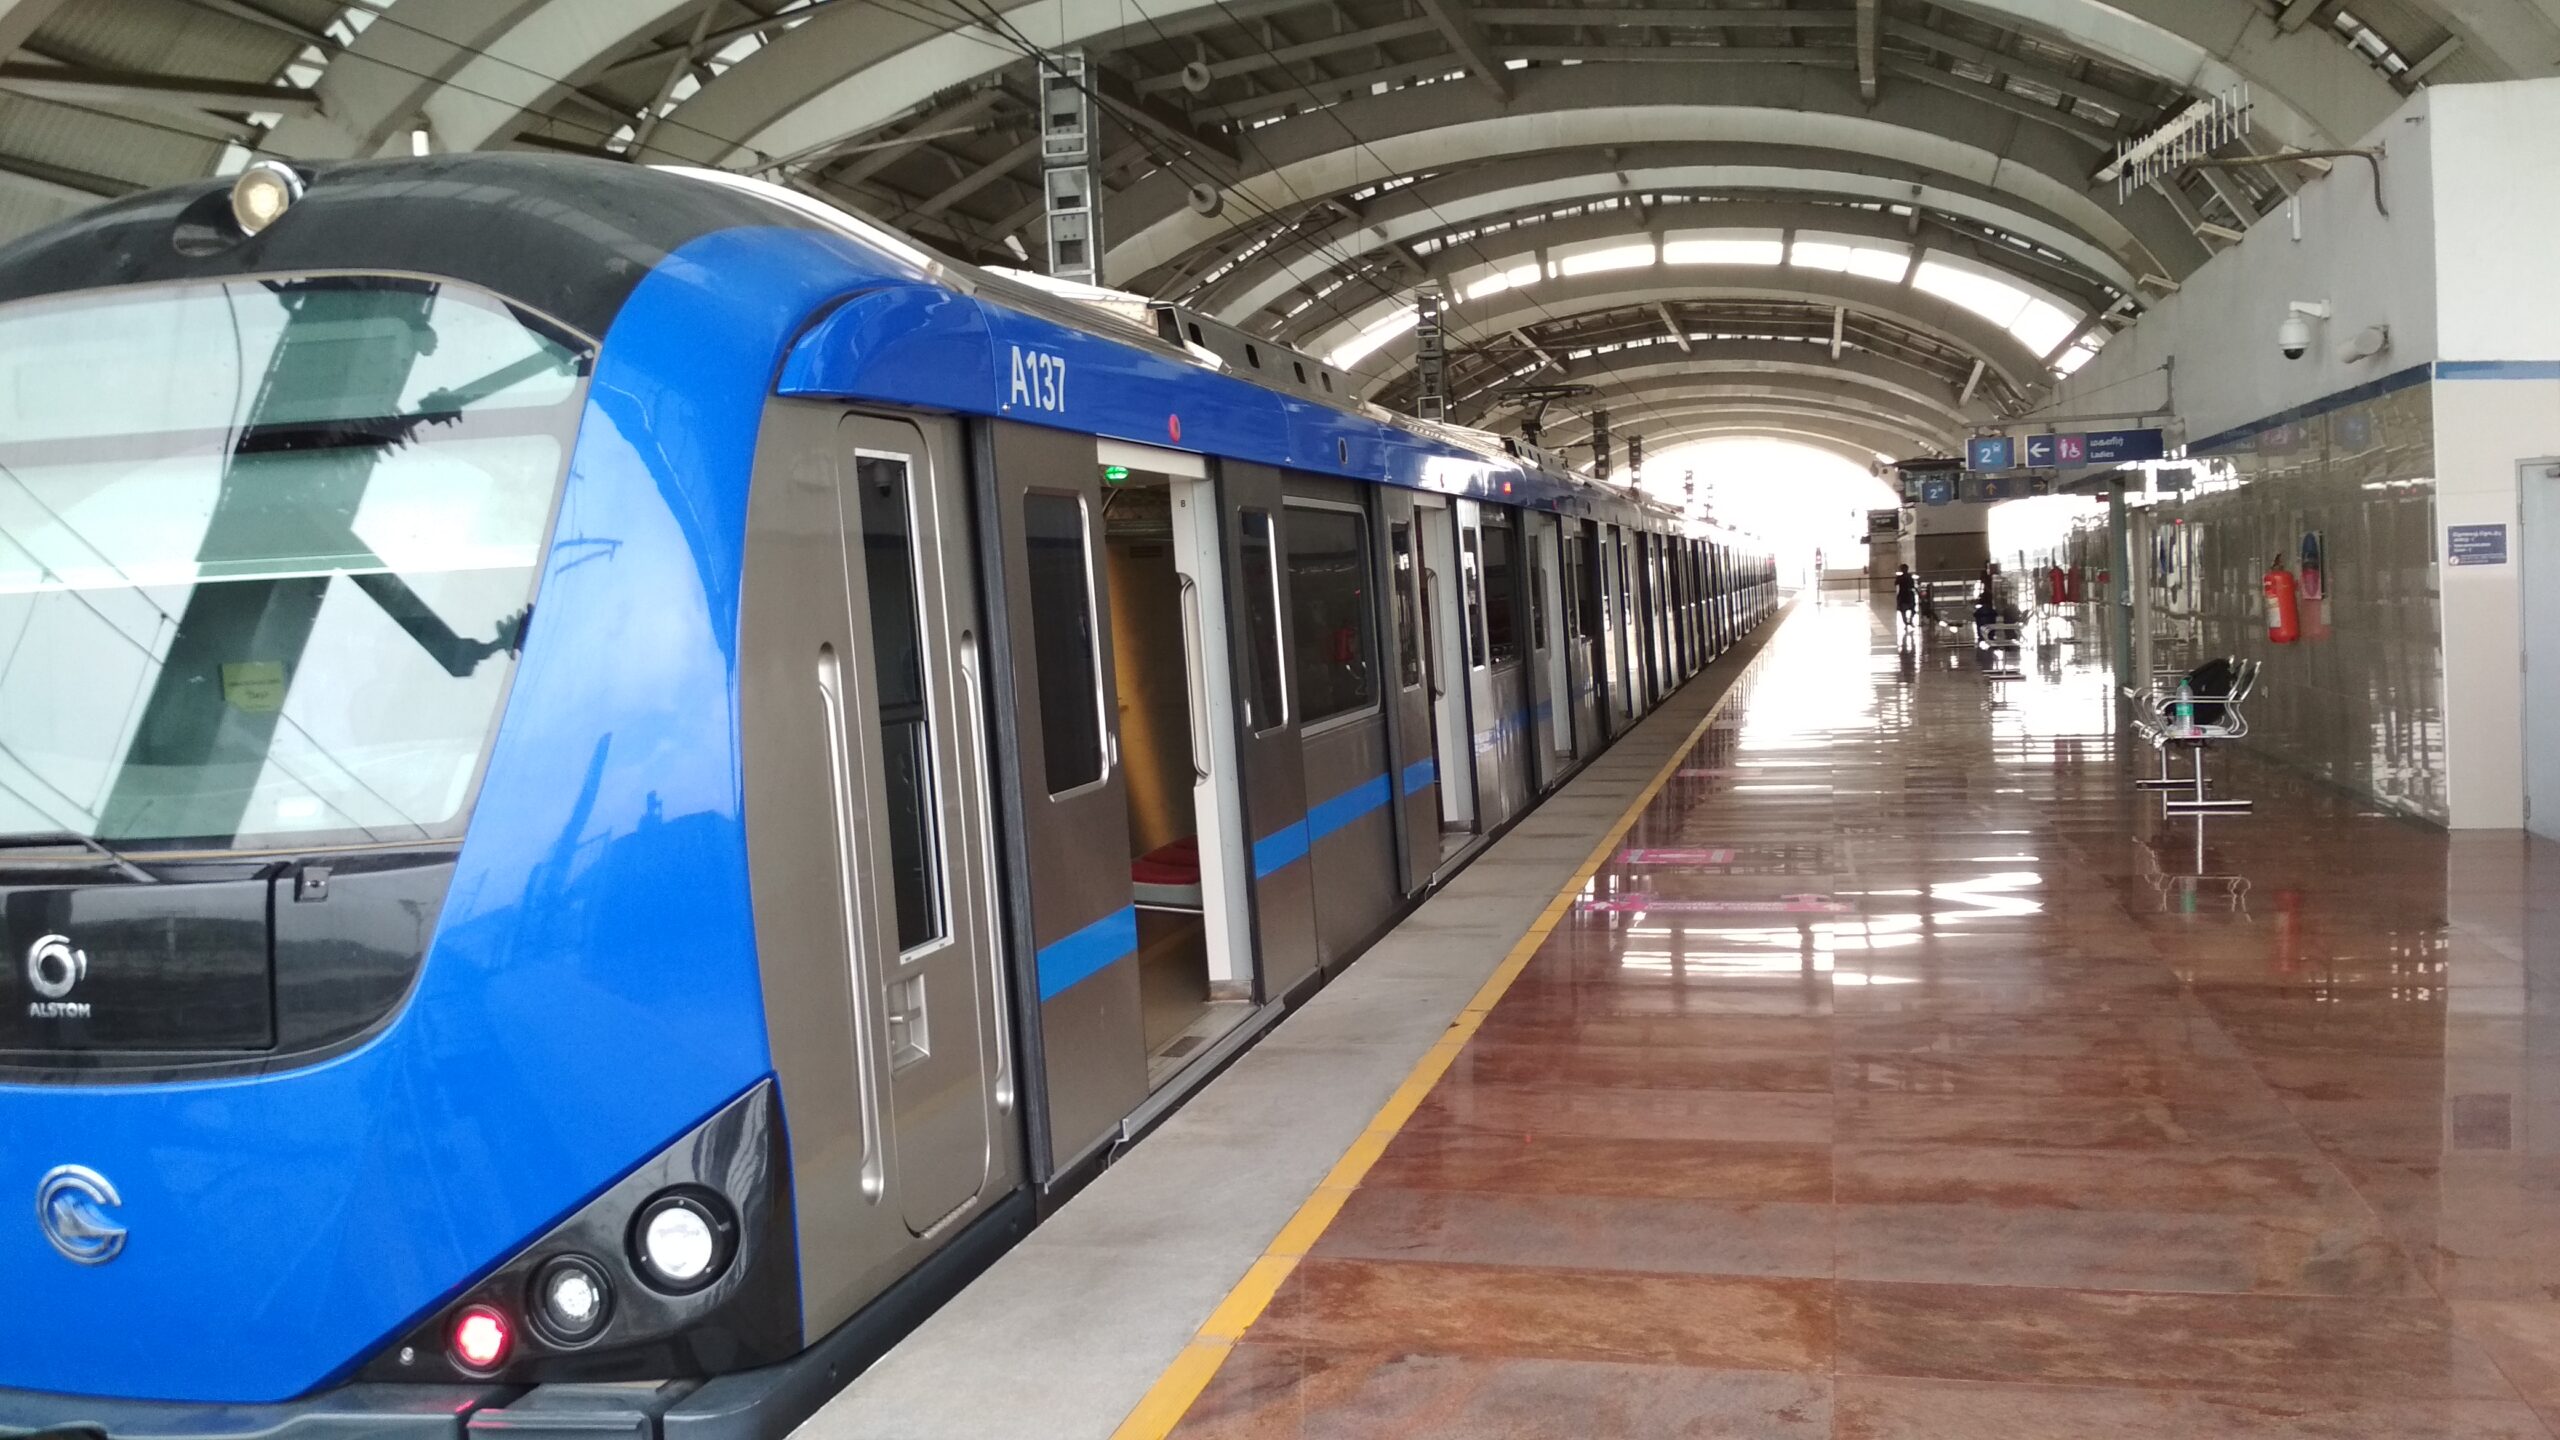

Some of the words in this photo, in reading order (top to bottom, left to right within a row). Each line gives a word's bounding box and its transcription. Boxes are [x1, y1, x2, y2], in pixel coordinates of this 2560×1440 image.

[1011, 345, 1066, 413] A137
[1981, 447, 1992, 463] 2
[2090, 450, 2115, 459] Ladies
[1930, 488, 1938, 499] 2
[29, 1001, 92, 1018] ALSTOM
